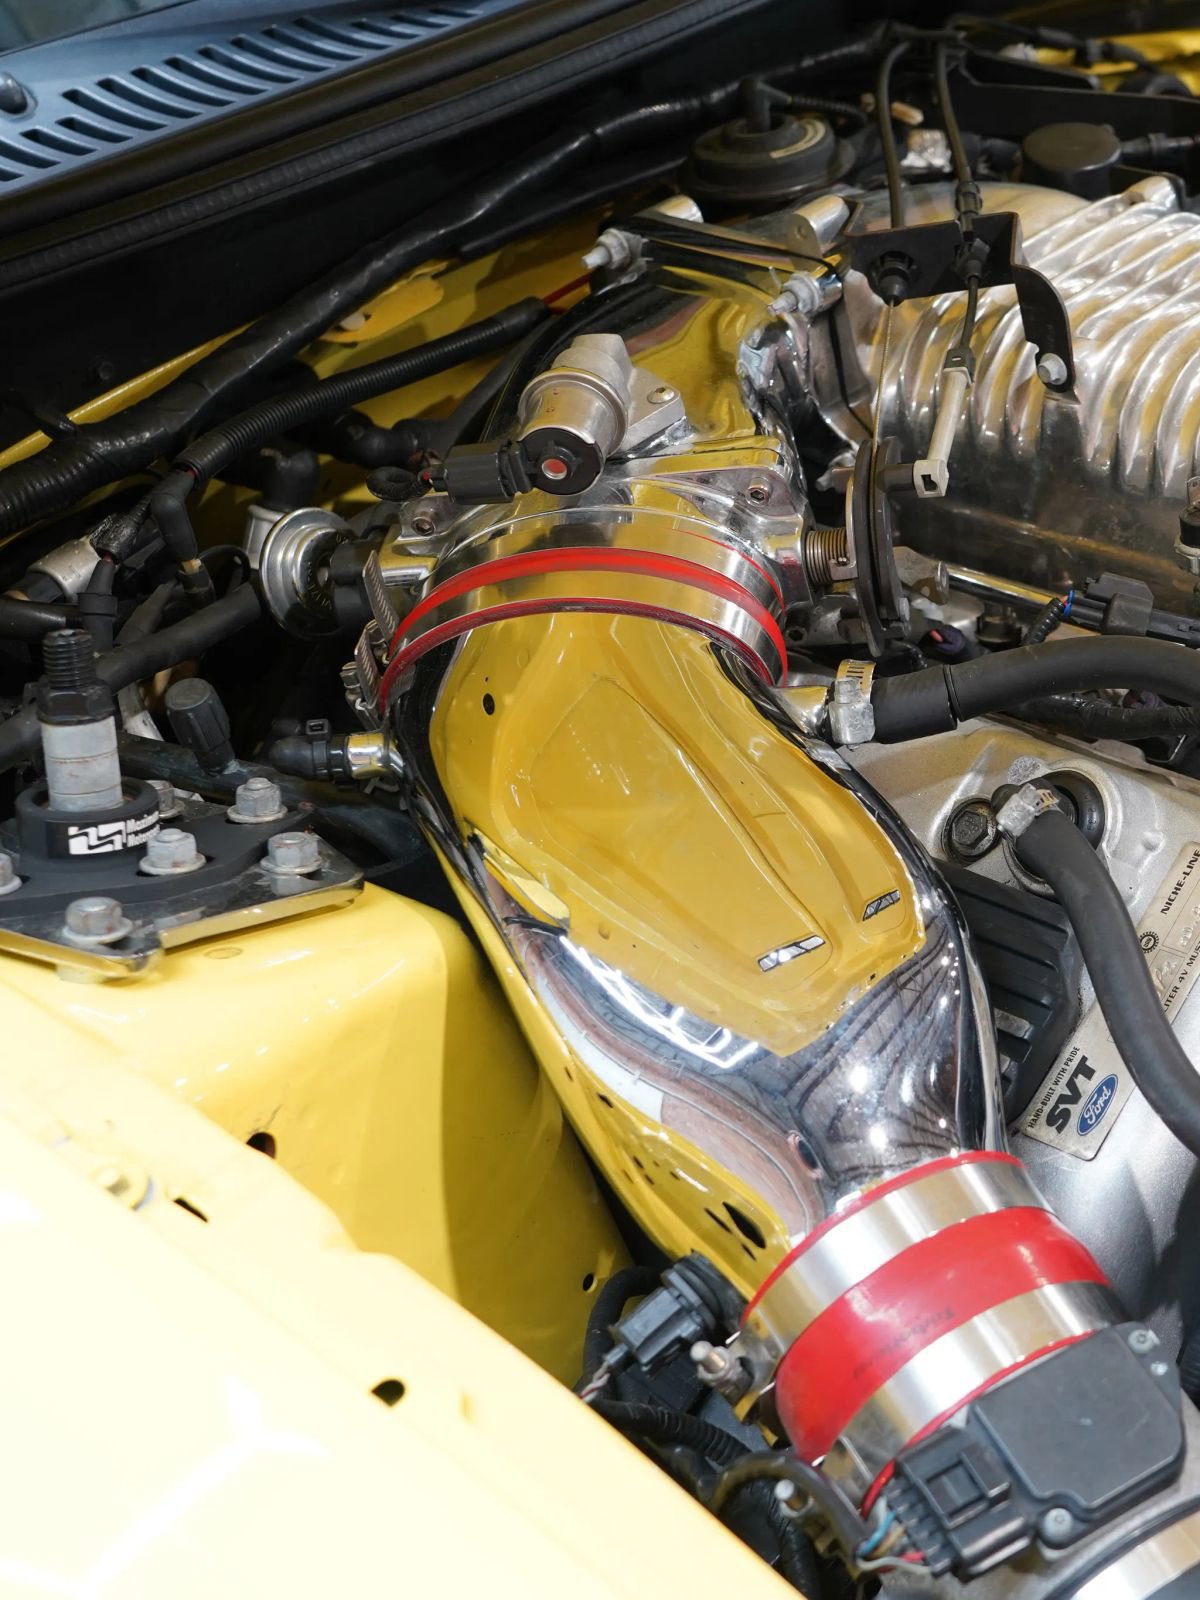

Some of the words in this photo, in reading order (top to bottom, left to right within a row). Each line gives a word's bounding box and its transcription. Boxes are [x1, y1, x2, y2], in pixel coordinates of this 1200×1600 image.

[1178, 969, 1189, 984] 4V
[1027, 1087, 1056, 1129] HAND-BUILT
[1052, 1067, 1068, 1086] WITH
[1063, 1046, 1080, 1068] PRIDE
[1046, 1054, 1096, 1134] SVT
